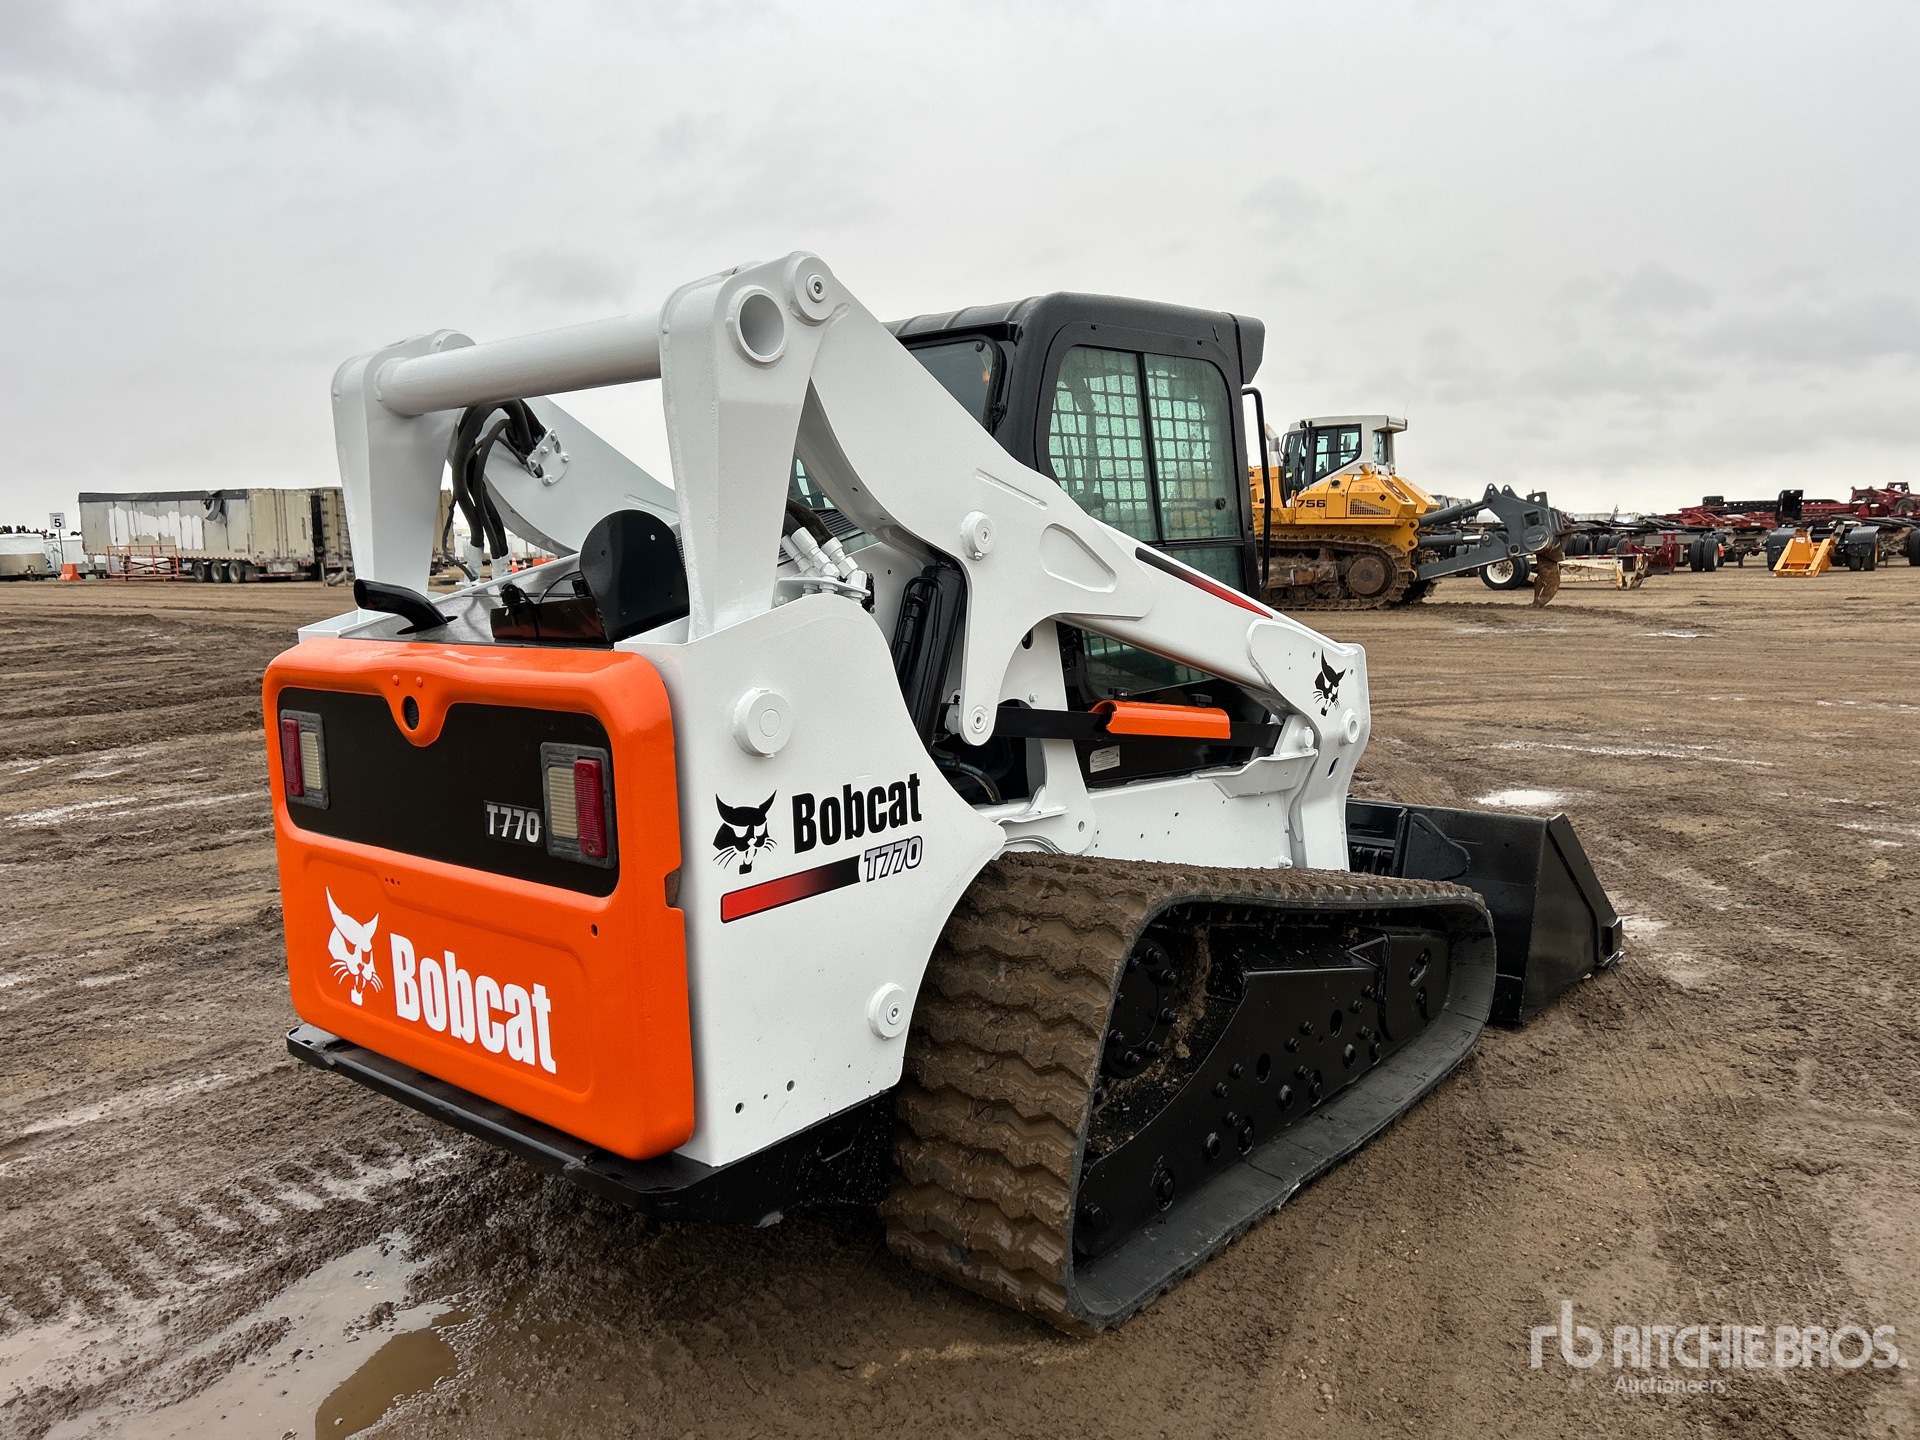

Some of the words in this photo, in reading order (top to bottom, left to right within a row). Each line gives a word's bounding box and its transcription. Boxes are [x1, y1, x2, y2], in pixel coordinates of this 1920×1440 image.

[54, 518, 62, 528] 5
[1296, 499, 1326, 508] 756
[486, 804, 541, 843] T770
[792, 772, 922, 854] Bobcat
[863, 835, 923, 882] T770
[389, 932, 556, 1074] Bobcat
